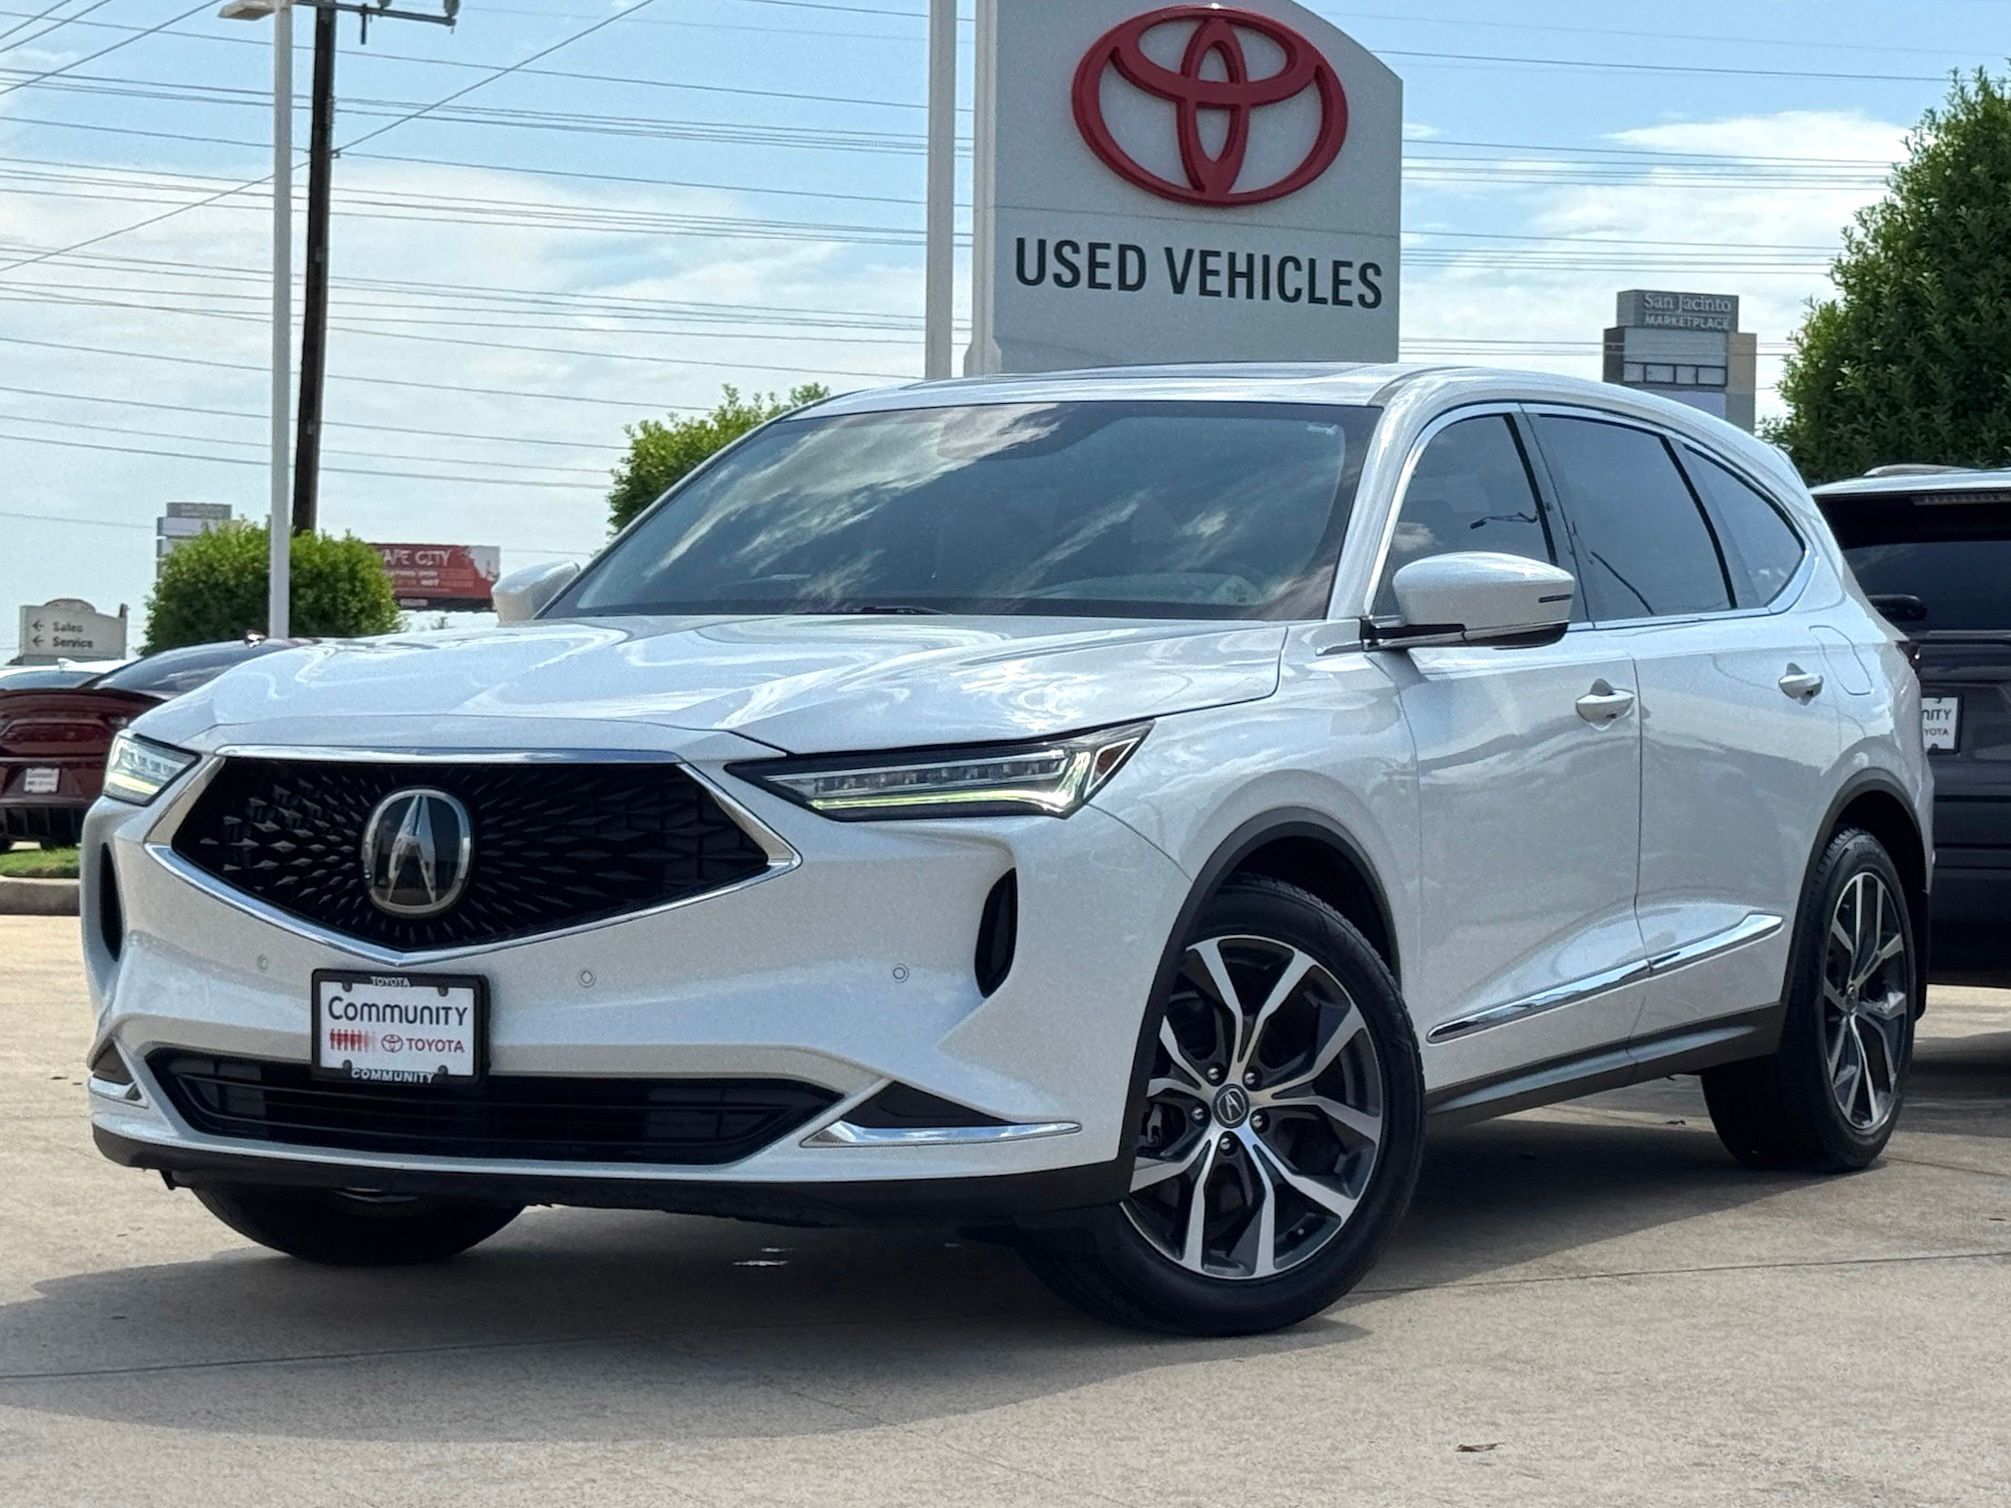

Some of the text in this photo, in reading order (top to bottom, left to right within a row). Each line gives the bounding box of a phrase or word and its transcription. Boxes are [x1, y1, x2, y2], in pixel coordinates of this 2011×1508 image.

[1016, 237, 1383, 310] USED VEHICLES
[1643, 293, 1731, 314] San Jacinto
[1644, 313, 1730, 329] MARKETPLACE
[53, 621, 84, 633] Sales
[53, 636, 94, 649] Service
[370, 976, 411, 988] TOYOTA
[406, 1038, 465, 1053] TOYOTA
[351, 1068, 435, 1084] COMMUNITY
